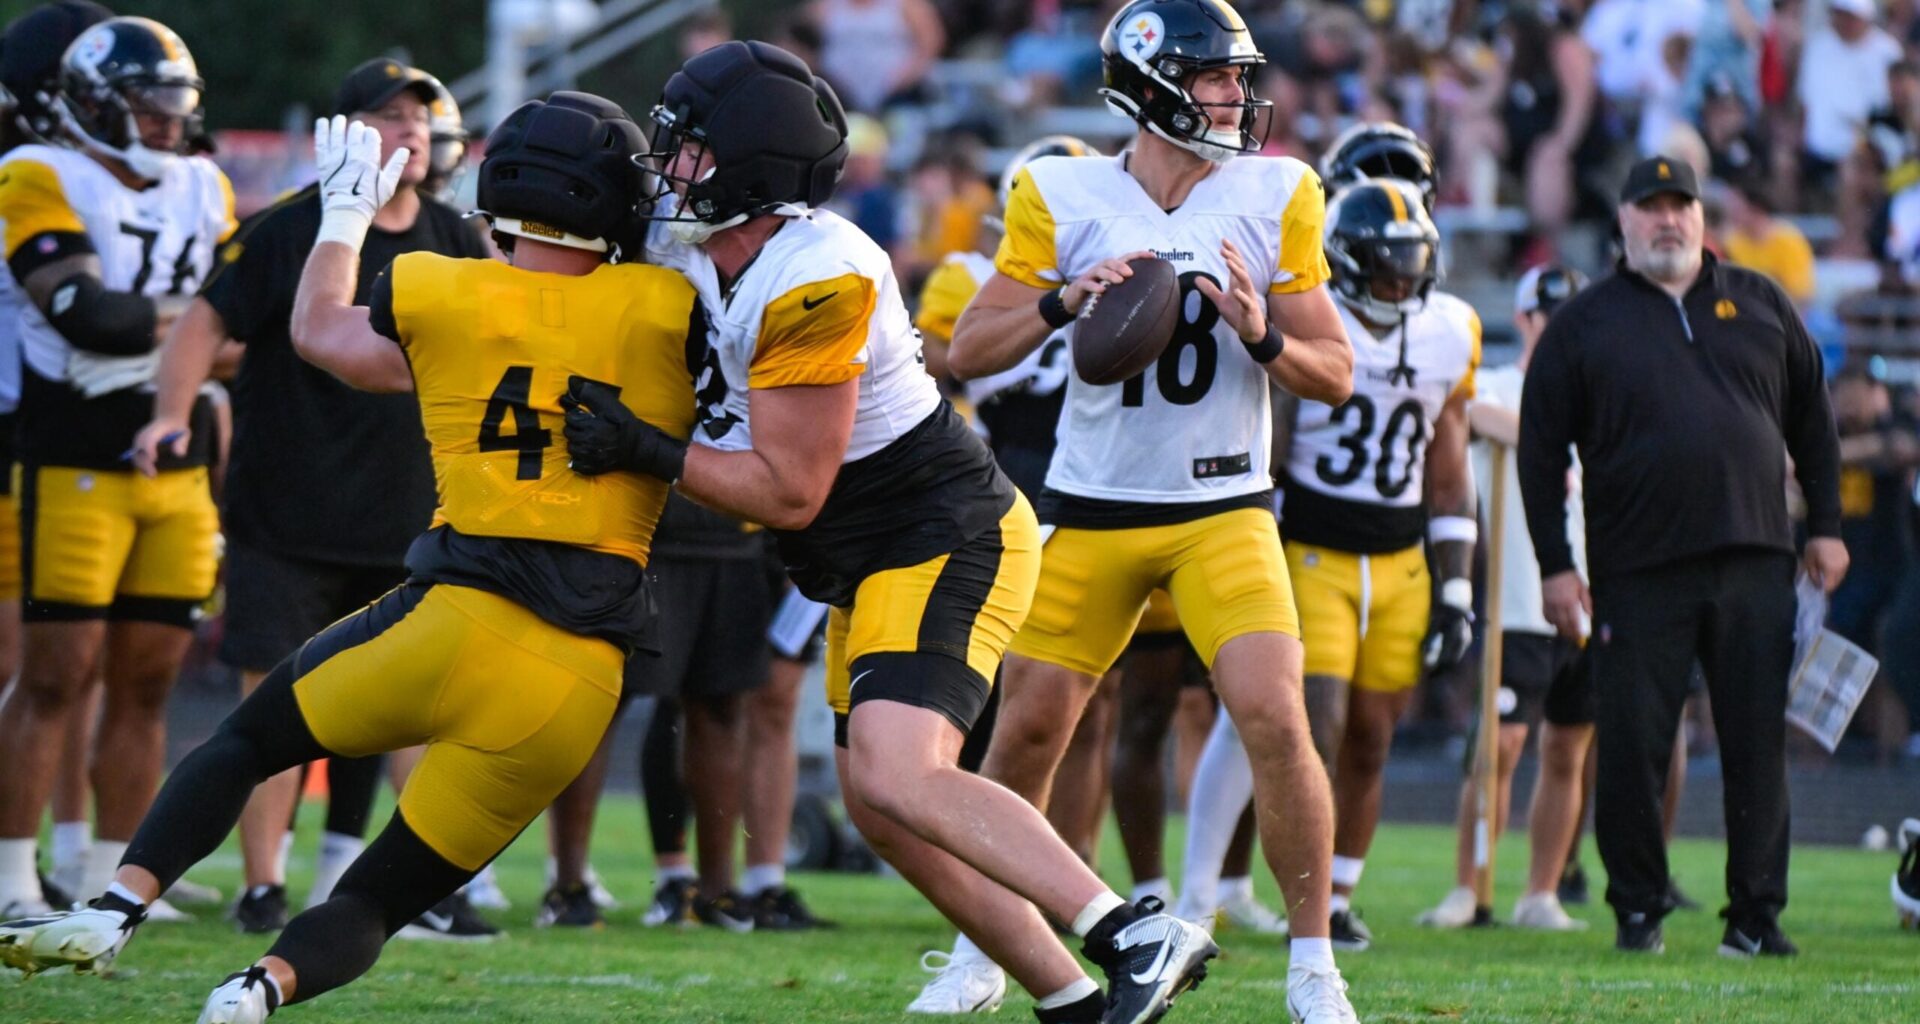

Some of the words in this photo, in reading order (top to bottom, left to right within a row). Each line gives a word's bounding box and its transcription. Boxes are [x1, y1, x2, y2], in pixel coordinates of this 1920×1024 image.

[1121, 270, 1222, 407] 8
[478, 366, 553, 481] 4
[1315, 393, 1425, 499] 30
